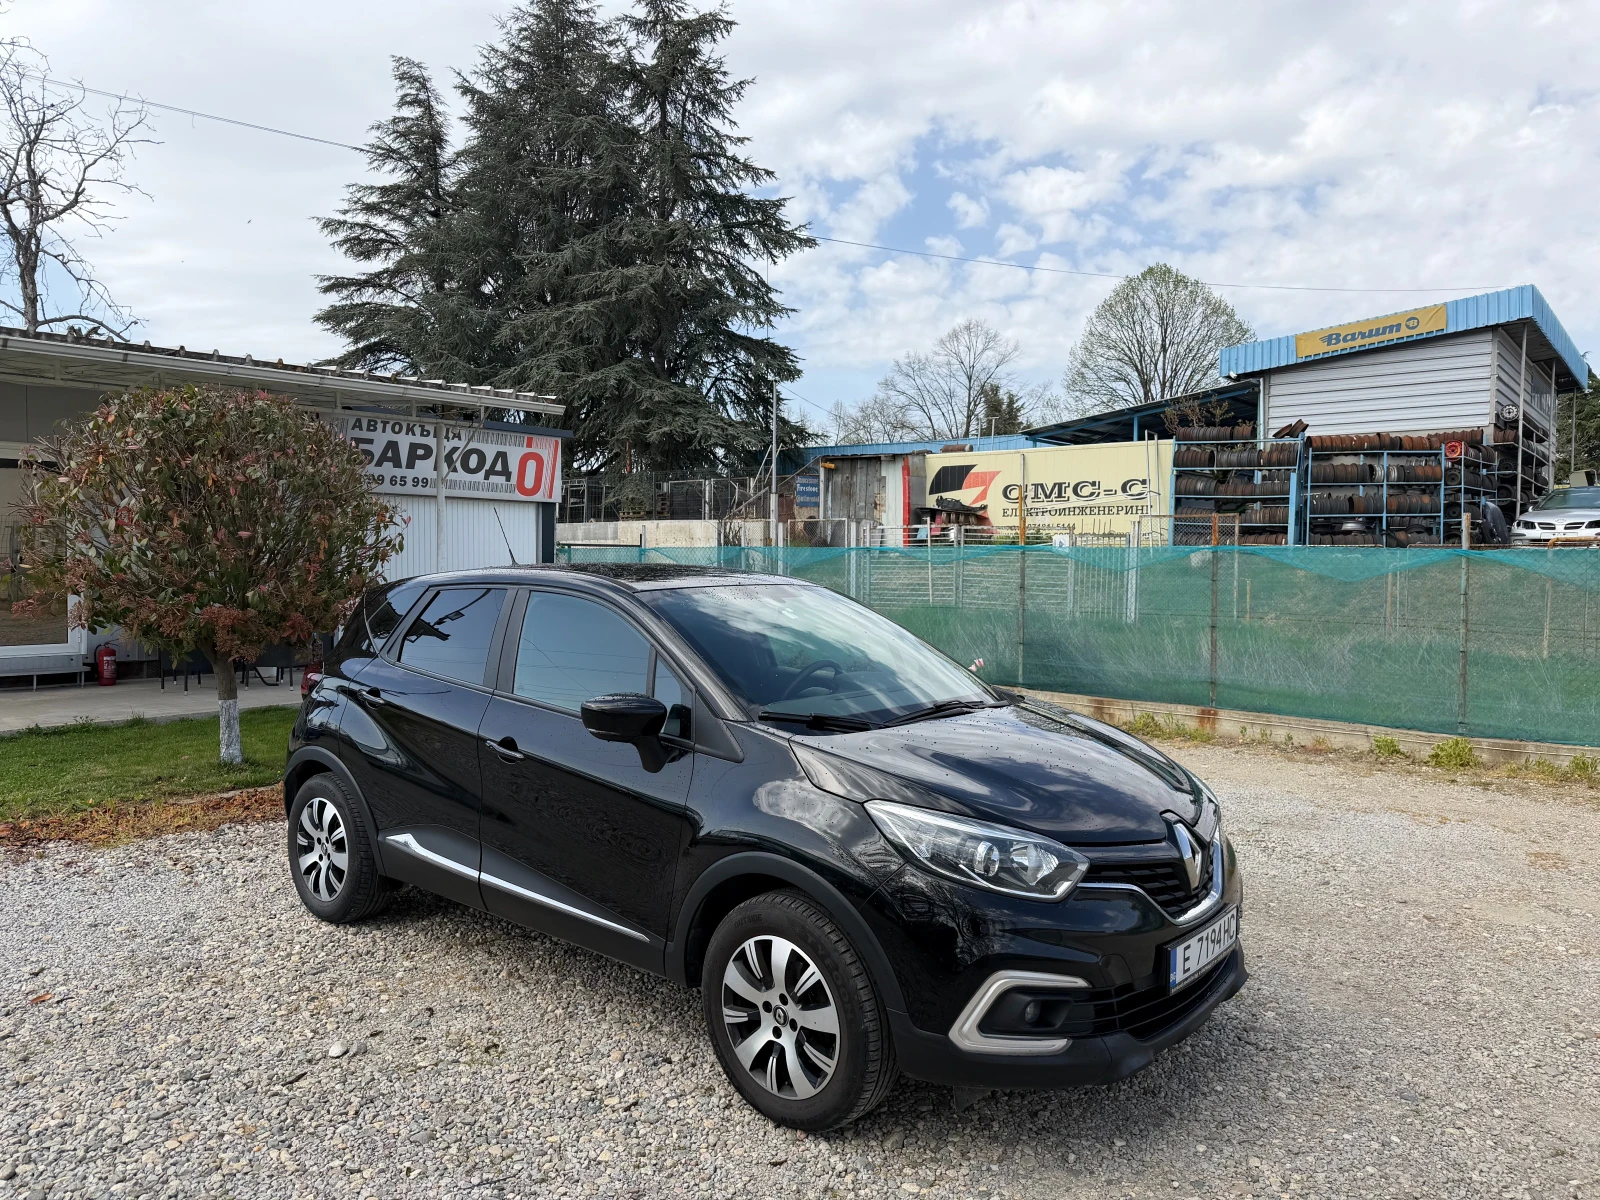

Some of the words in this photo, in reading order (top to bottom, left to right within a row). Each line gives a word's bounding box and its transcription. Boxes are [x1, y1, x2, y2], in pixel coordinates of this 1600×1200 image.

[1319, 322, 1402, 346] Barum
[350, 437, 512, 483] БАРКОД
[389, 475, 408, 487] 65
[411, 476, 429, 488] 99
[1002, 504, 1153, 518] ЕЛКТРОИНЖЕНЕРИНГ
[734, 913, 763, 928] OUTSIDE
[1182, 943, 1191, 975] E
